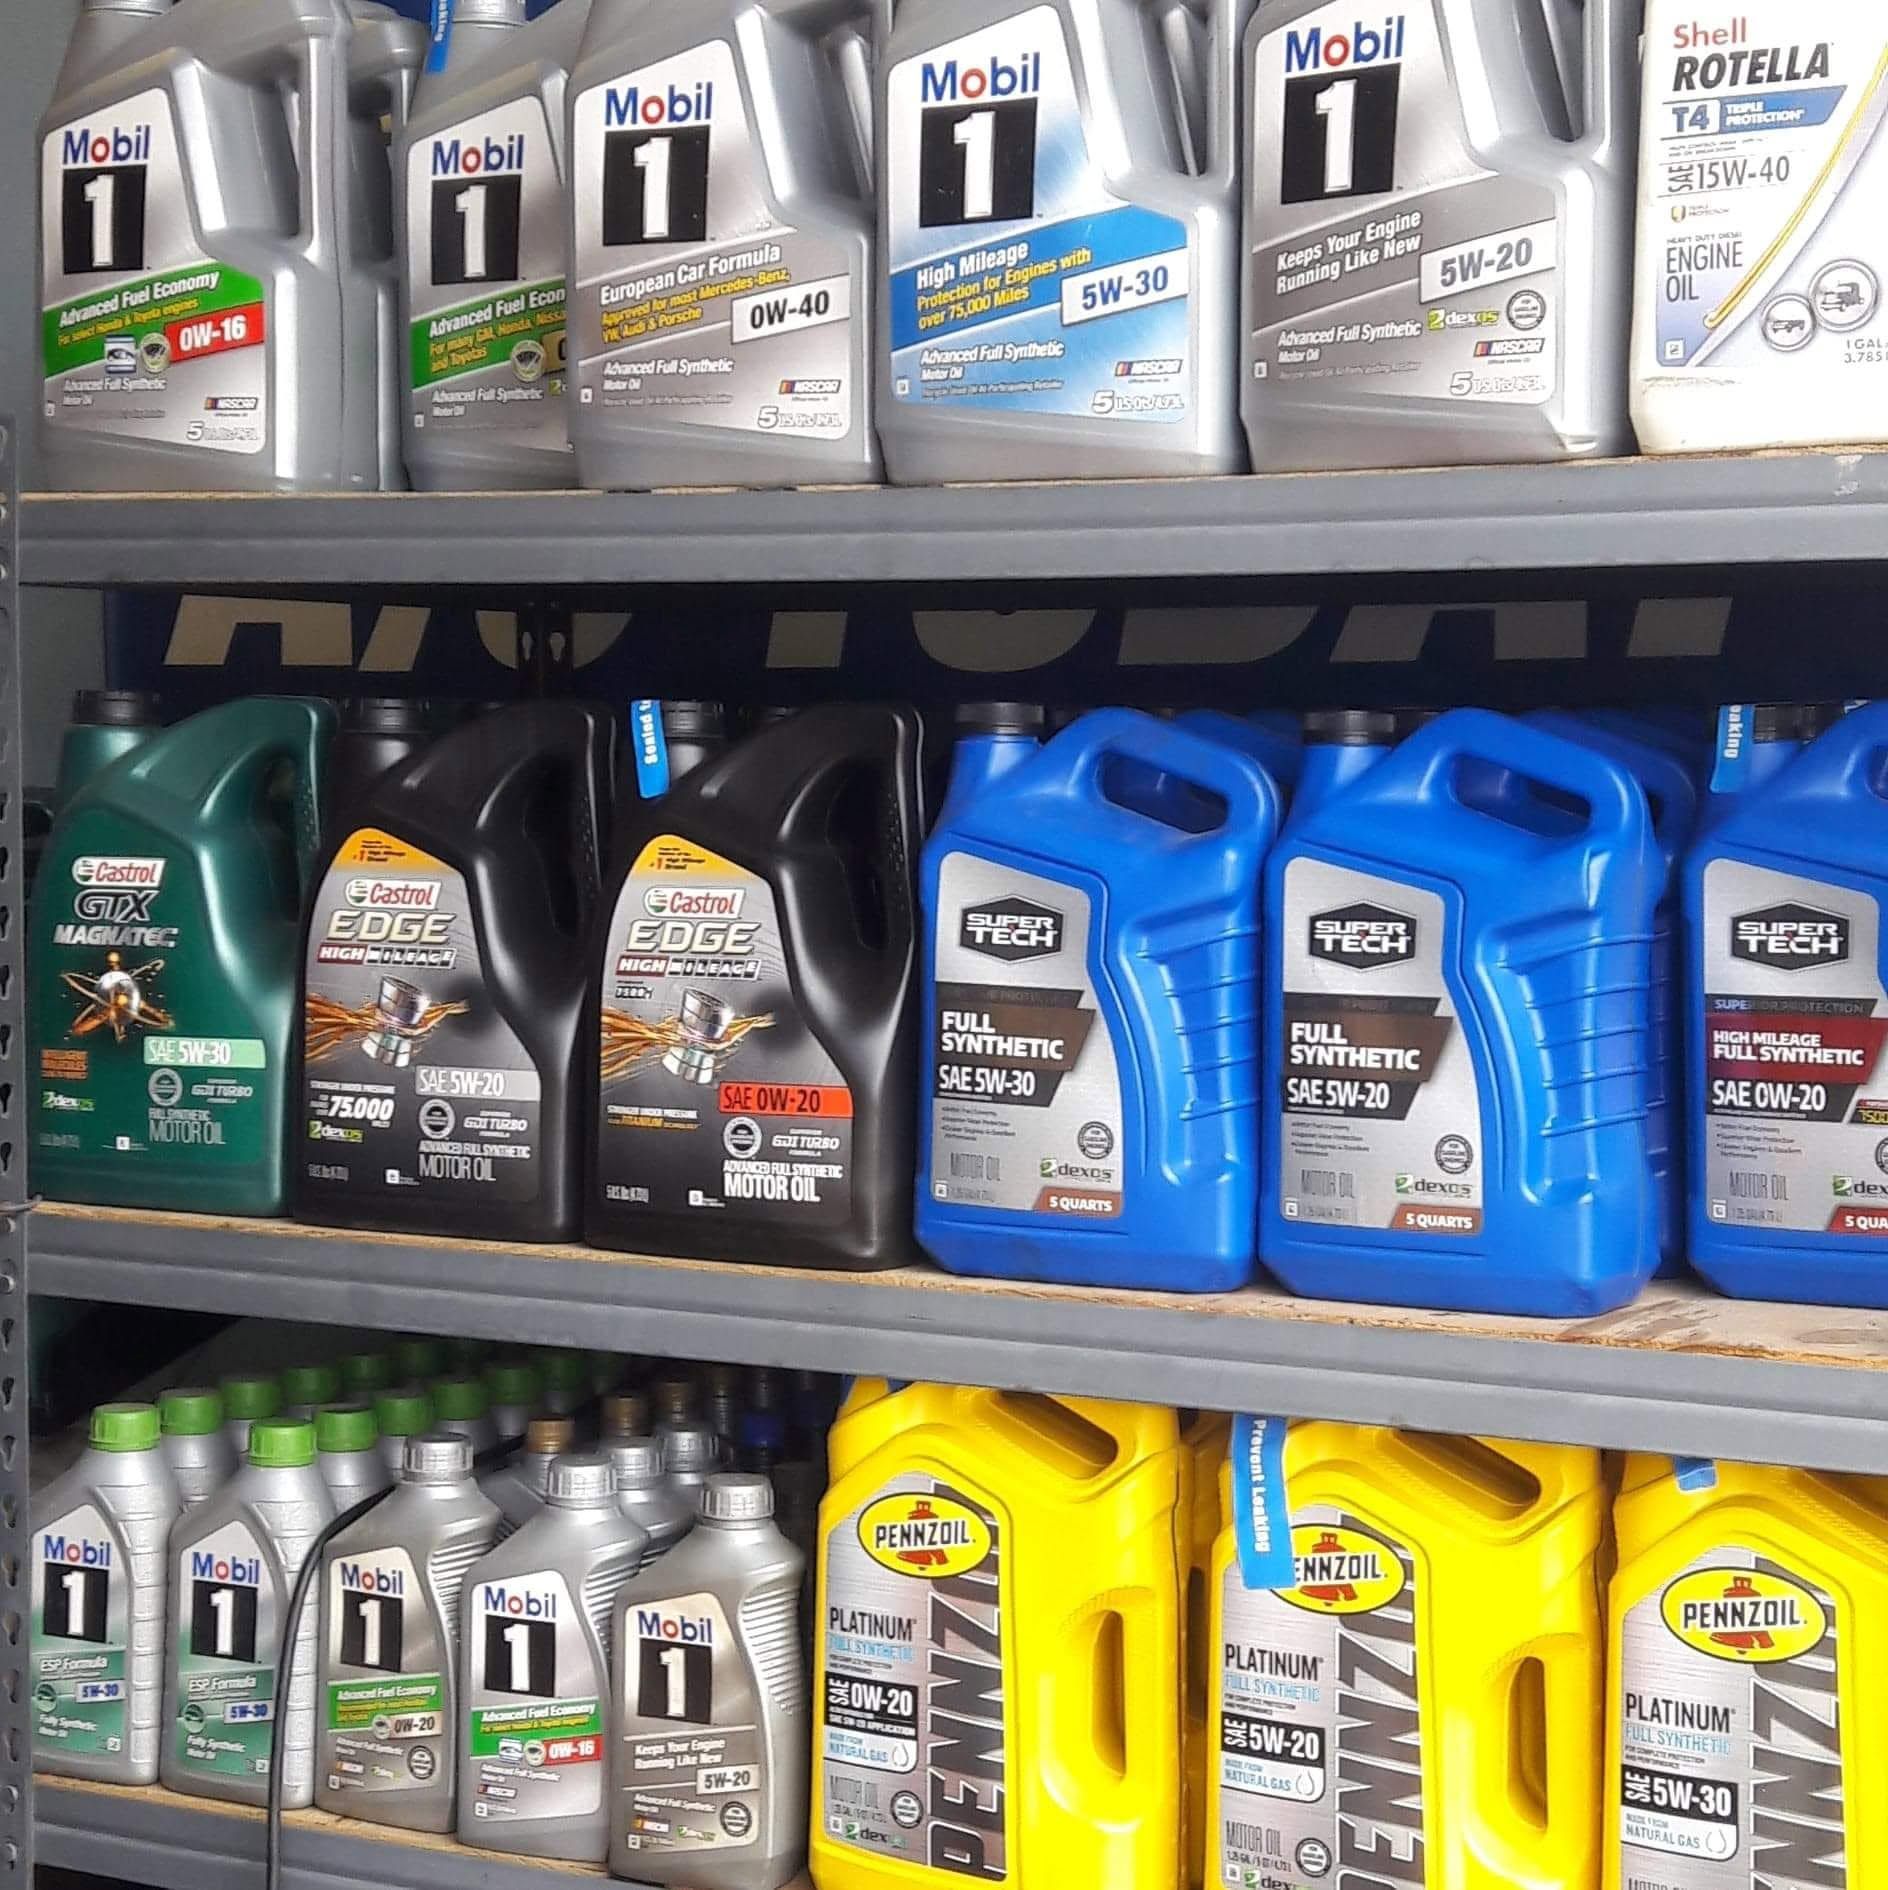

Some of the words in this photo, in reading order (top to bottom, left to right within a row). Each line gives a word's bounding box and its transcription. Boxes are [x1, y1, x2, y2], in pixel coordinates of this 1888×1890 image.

[1285, 15, 1405, 73] Mobil
[1673, 16, 1747, 48] Shell
[921, 52, 1040, 102] Mobil
[1672, 43, 1829, 91] ROTELLA
[605, 82, 713, 126] Mobil
[1672, 105, 1709, 132] T4
[1725, 102, 1764, 115] TRIPLE
[1725, 109, 1804, 127] PROTECTION
[62, 125, 151, 165] Mobil
[1315, 78, 1357, 193] 1
[431, 135, 524, 176] Mobil
[953, 111, 996, 220] 1
[634, 137, 671, 238] 1
[1668, 164, 1693, 192] SAE
[1698, 155, 1790, 189] 15W-40
[84, 174, 114, 268] 1
[456, 185, 486, 277] 1
[1276, 242, 1322, 272] Keeps
[1326, 230, 1362, 258] Your
[1365, 210, 1421, 242] Engine
[916, 261, 955, 290] High
[959, 241, 1030, 279] Mileage
[1276, 260, 1340, 295] Running
[1344, 250, 1378, 273] Like
[1383, 234, 1421, 259] New
[1440, 238, 1533, 288] 5W-20
[1666, 241, 1743, 274] ENGINE
[600, 273, 675, 305] European
[676, 264, 705, 286] Car
[708, 244, 781, 276] Formula
[916, 279, 981, 311] Protection
[983, 274, 1002, 291] for
[1005, 259, 1057, 285] Engines
[1060, 248, 1091, 269] with
[1082, 265, 1168, 311] 5W-30
[1666, 275, 1699, 302] OIL
[59, 295, 119, 328] Advanced
[122, 289, 149, 308] Fuel
[153, 271, 220, 298] Economy
[750, 290, 830, 329] 0W-40
[918, 310, 946, 330] over
[949, 298, 990, 323] 75,000
[994, 287, 1030, 308] Miles
[429, 303, 493, 338] Advanced
[496, 294, 525, 317] Fuel
[179, 315, 247, 351] 0W-16
[1278, 329, 1334, 348] Advanced
[1336, 326, 1360, 342] Full
[1361, 320, 1422, 342] Synthetic
[603, 360, 654, 375] Advanced
[656, 359, 677, 374] Full
[678, 357, 734, 375] Synthetic
[920, 348, 978, 366] Advanced
[980, 345, 1002, 362] Full
[1004, 340, 1065, 362] Synthetic
[431, 390, 476, 403] Advanced
[478, 390, 496, 401] Full
[497, 388, 543, 403] Synthetic
[95, 861, 157, 883] Castrol
[75, 889, 160, 922] GTX
[370, 882, 434, 905] Castrol
[669, 892, 735, 914] Castrol
[53, 925, 179, 947] MAGNATEC
[326, 909, 456, 944] EDGE
[627, 919, 761, 954] EDGE
[966, 914, 1054, 929] SUPER
[966, 927, 1055, 947] TECH
[1314, 921, 1406, 935] SUPER
[1738, 922, 1838, 935] SUPER
[319, 946, 363, 962] HIGH
[1314, 935, 1407, 953] TECH
[1738, 935, 1839, 954] TECH
[619, 958, 667, 972] HIGH
[942, 1011, 996, 1033] FULL
[1291, 1023, 1347, 1044] FULL
[149, 1039, 176, 1063] SAE
[178, 1040, 231, 1065] 5W-30
[941, 1033, 1064, 1059] SYNTHETIC
[1713, 1030, 1749, 1043] HIGH
[1752, 1032, 1821, 1047] MILEAGE
[1291, 1045, 1420, 1070] SYNTHETIC
[1713, 1045, 1757, 1060] FULL
[1760, 1046, 1864, 1065] SYNTHETIC
[419, 1068, 448, 1093] SAE
[450, 1070, 504, 1097] 5W-20
[939, 1065, 972, 1091] SAE
[975, 1068, 1035, 1096] 5W-30
[1287, 1078, 1324, 1105] SAE
[1326, 1081, 1390, 1109] 5W-20
[1712, 1080, 1751, 1106] SAE
[1755, 1082, 1826, 1111] 0W-20
[723, 1088, 752, 1109] SAE
[757, 1089, 820, 1112] 0W-20
[150, 1120, 200, 1143] MOTOR
[203, 1121, 226, 1144] OIL
[800, 1136, 840, 1149] TURBO
[419, 1154, 471, 1180] MOTOR
[476, 1156, 497, 1181] OIL
[723, 1160, 770, 1174] ADVANCED
[771, 1162, 793, 1175] FULL
[793, 1164, 843, 1179] SYNTHETIC
[724, 1173, 789, 1200] MOTOR
[791, 1176, 821, 1202] OIL
[1050, 1196, 1058, 1208] 5
[1060, 1197, 1112, 1212] QUARTS
[1406, 1213, 1415, 1225] 5
[1416, 1213, 1473, 1228] QUARTS
[1845, 1216, 1854, 1227] 5
[1251, 1419, 1267, 1482] Prevent
[876, 1520, 970, 1548] PENNZOIL
[1252, 1487, 1271, 1552] Leaking
[44, 1535, 111, 1566] Mobil
[193, 1552, 259, 1584] Mobil
[341, 1563, 403, 1595] Mobil
[62, 1570, 86, 1636] 1
[485, 1585, 556, 1618] Mobil
[1683, 1600, 1800, 1628] PENNZOIL
[211, 1589, 234, 1656] 1
[359, 1600, 381, 1666] 1
[638, 1610, 712, 1644] Mobil
[830, 1607, 912, 1642] PLATINUM
[504, 1623, 530, 1691] 1
[1225, 1644, 1318, 1682] PLATINUM
[82, 1683, 119, 1698] 5W-30
[660, 1648, 685, 1717] 1
[829, 1679, 849, 1706] SAE
[851, 1683, 913, 1717] 0W-20
[230, 1704, 268, 1719] 5W-30
[394, 1716, 435, 1733] 0W-20
[1626, 1692, 1730, 1734] PLATINUM
[548, 1740, 595, 1759] 0W-16
[635, 1744, 665, 1756] Keeps
[667, 1741, 689, 1753] Your
[691, 1738, 726, 1750] Engine
[1224, 1718, 1247, 1747] SAE
[1249, 1724, 1319, 1761] 5W-20
[1626, 1722, 1655, 1744] FULL
[1658, 1729, 1730, 1754] SYNTHETIC
[704, 1770, 750, 1790] 5W-20
[1624, 1771, 1651, 1803] SAE
[1653, 1777, 1732, 1817] 5W-30
[1626, 1826, 1676, 1845] NATURAL
[1678, 1834, 1700, 1849] GAS
